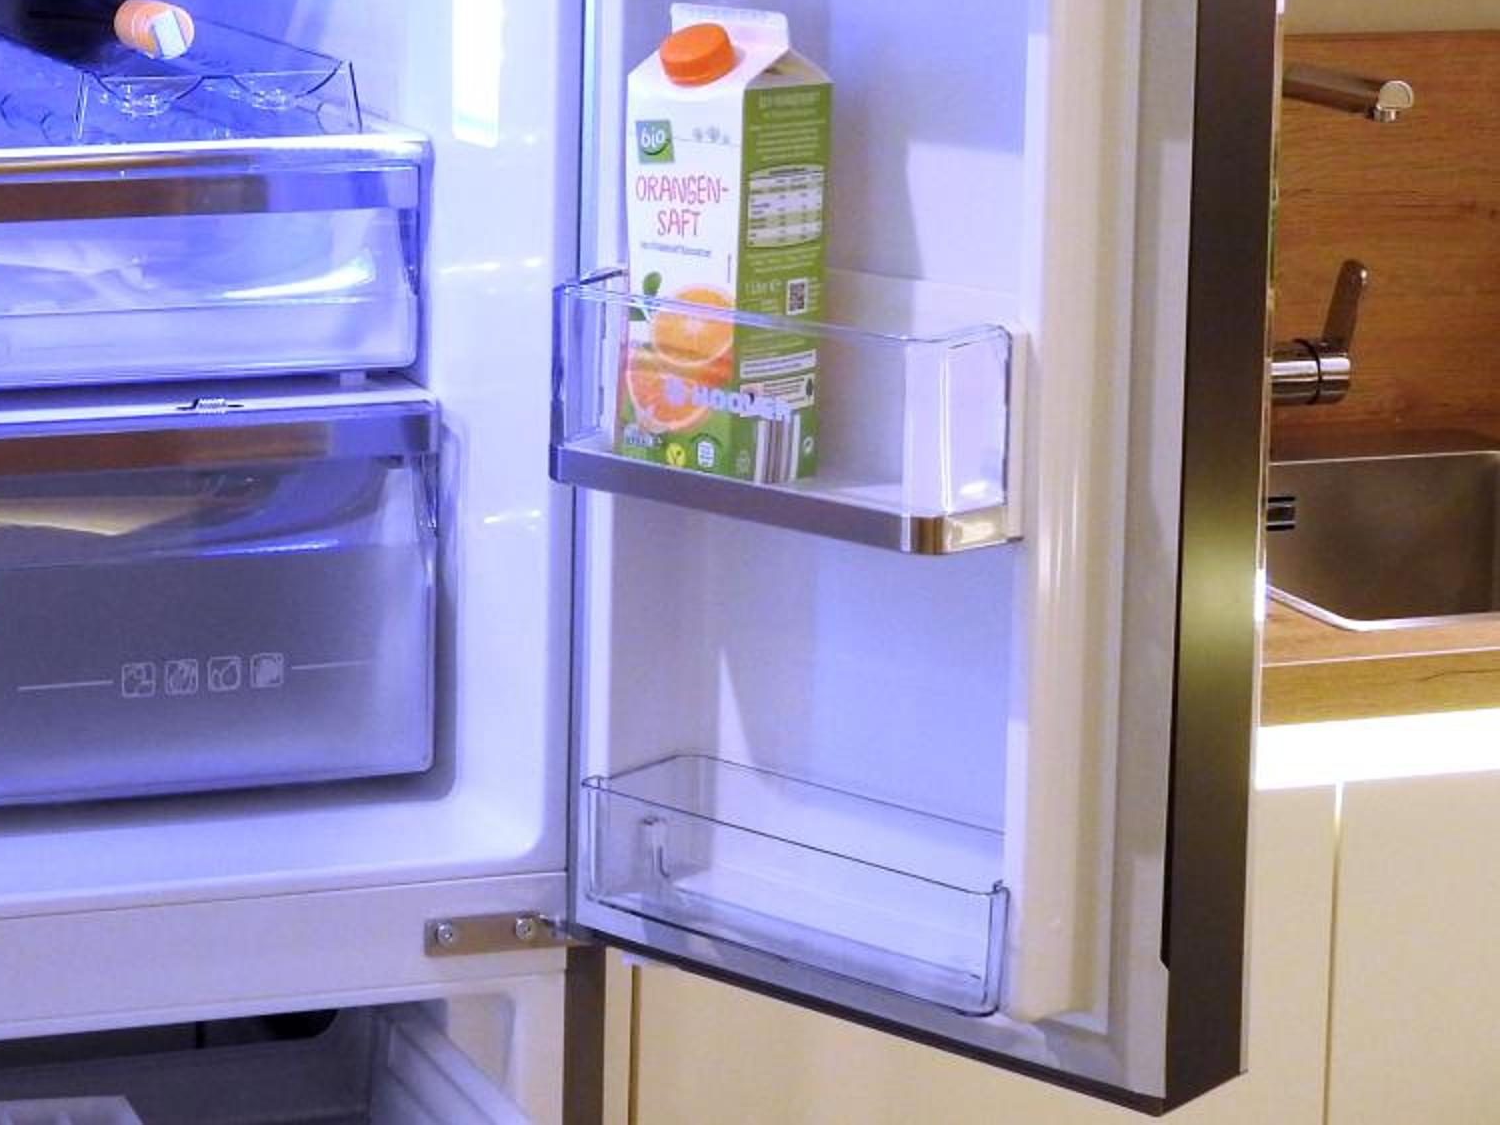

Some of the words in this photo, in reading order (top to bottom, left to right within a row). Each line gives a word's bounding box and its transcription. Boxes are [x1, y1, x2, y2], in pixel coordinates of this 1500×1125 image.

[641, 127, 666, 148] bio
[635, 175, 730, 205] ORANGEN-
[657, 208, 701, 239] SAFT
